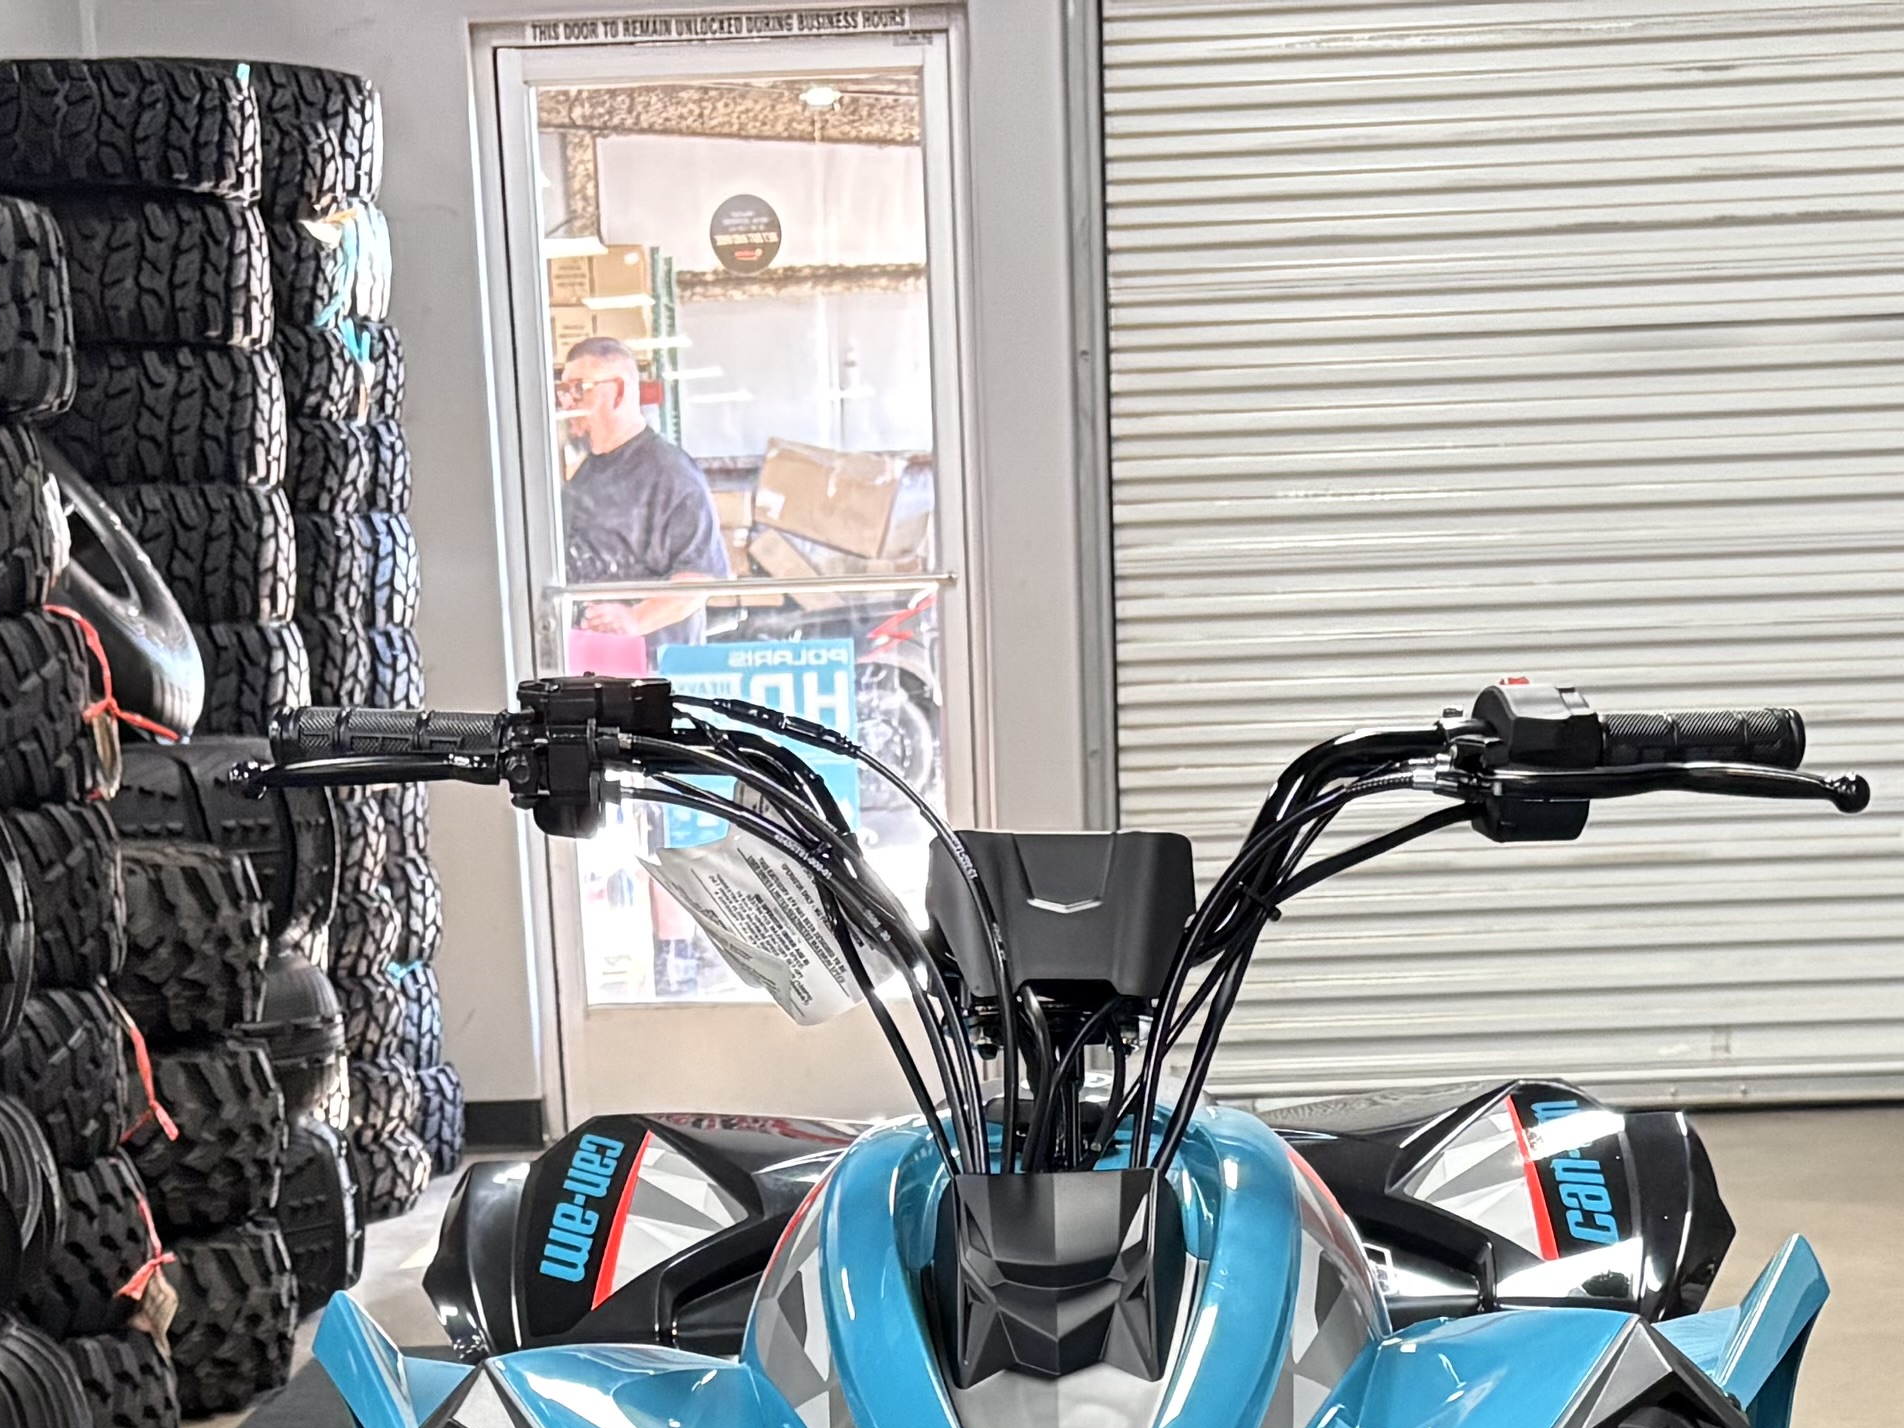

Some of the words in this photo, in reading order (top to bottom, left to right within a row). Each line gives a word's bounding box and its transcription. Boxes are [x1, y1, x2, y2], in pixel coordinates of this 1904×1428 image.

[532, 23, 559, 42] THIS
[564, 22, 596, 40] DOOR
[602, 20, 619, 39] TO
[623, 18, 672, 38] REMAIN
[675, 16, 743, 37] UNLOCKED
[746, 14, 793, 33] DURING
[798, 11, 858, 32] BUSINESS
[862, 8, 905, 29] HOURS
[539, 1133, 625, 1283] can-am
[1531, 1100, 1620, 1245] can-m
